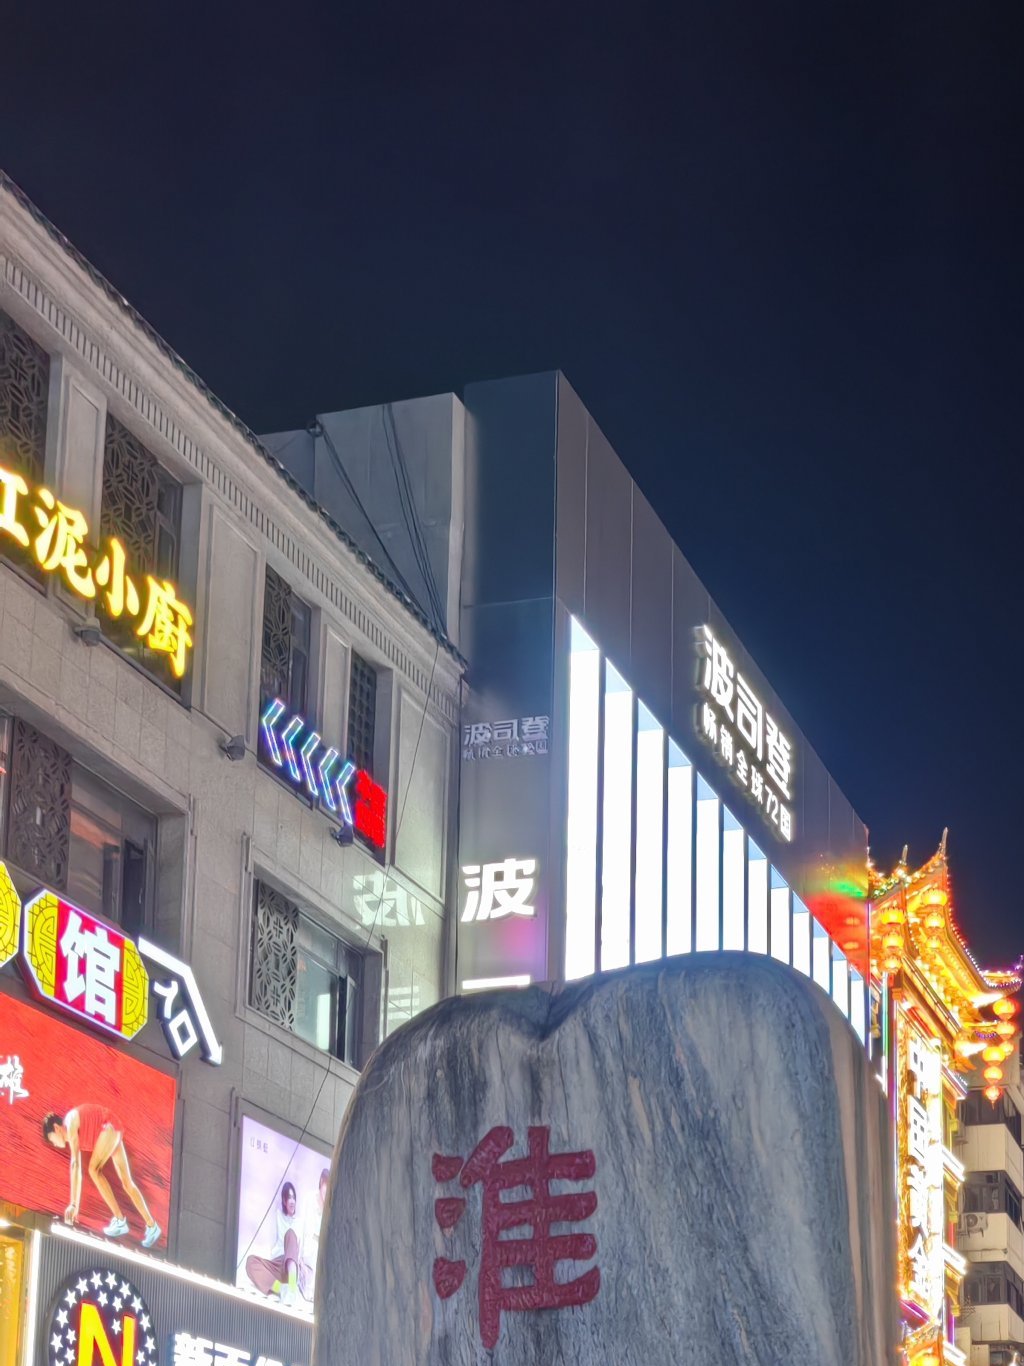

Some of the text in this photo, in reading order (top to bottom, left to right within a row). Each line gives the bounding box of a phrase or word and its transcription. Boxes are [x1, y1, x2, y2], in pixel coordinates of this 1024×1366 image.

[703, 625, 791, 799] 波司登
[703, 702, 792, 842] 畅销全球72国
[60, 912, 120, 1026] 馆
